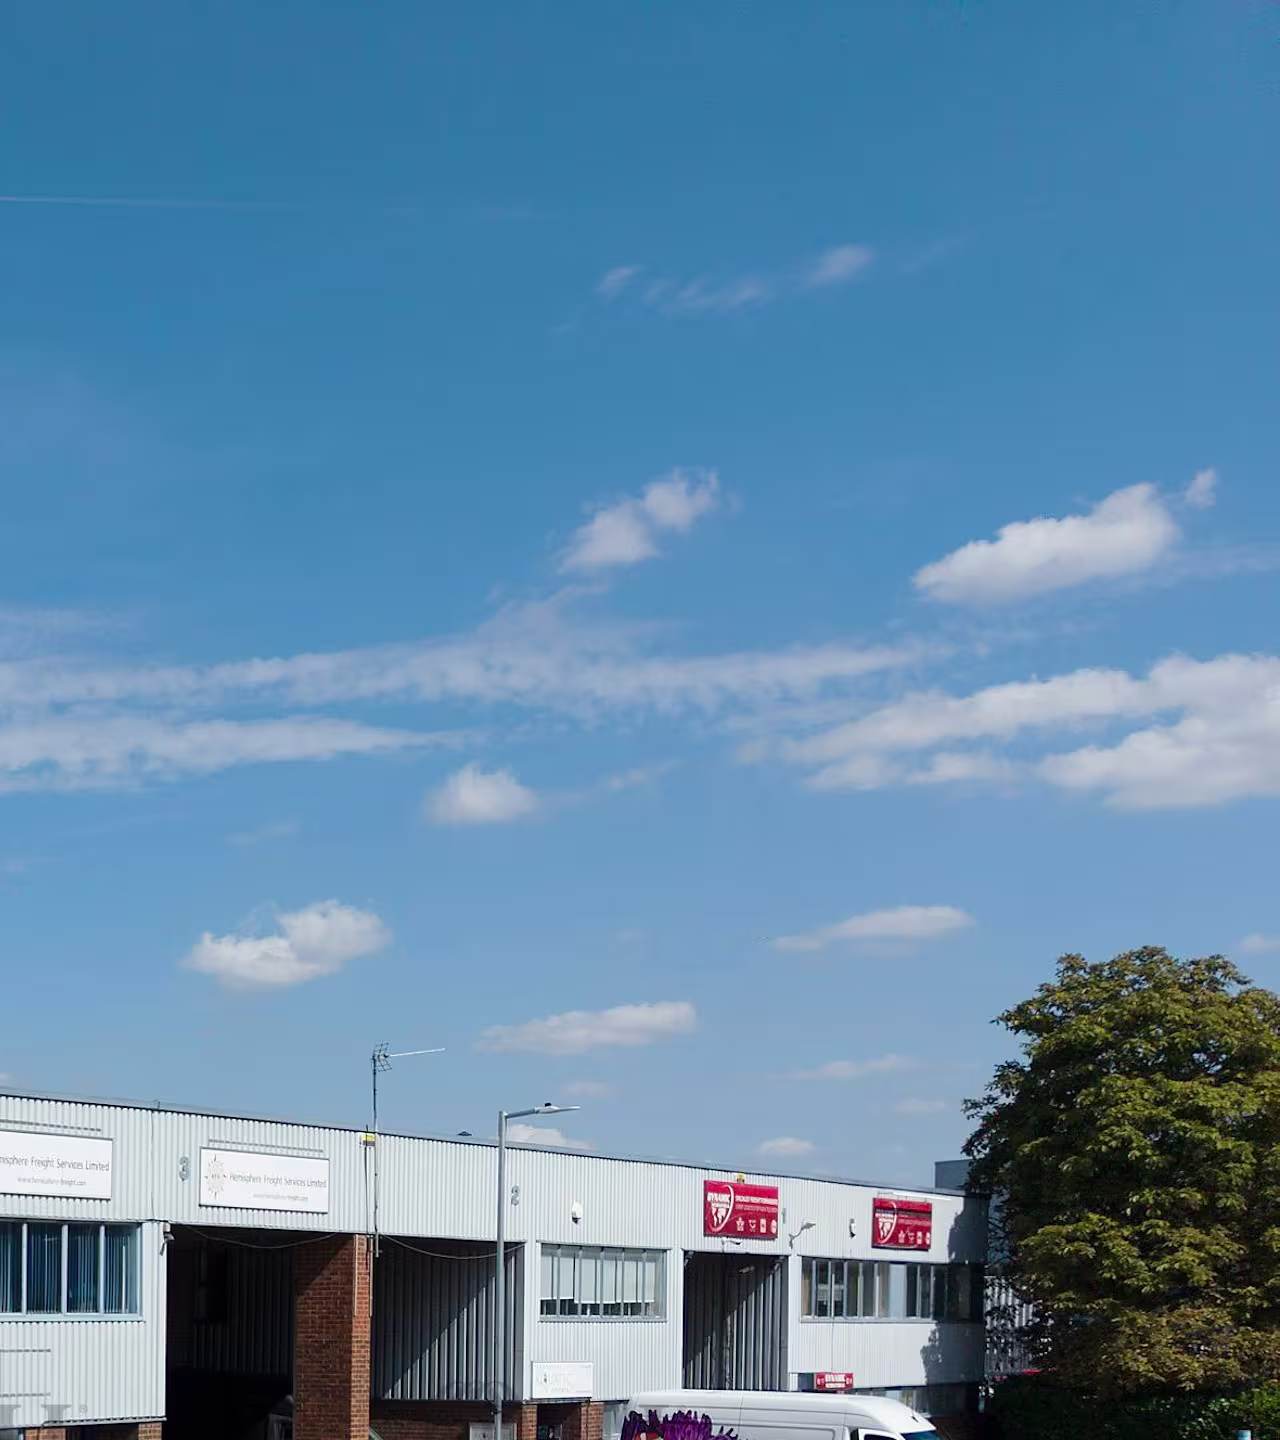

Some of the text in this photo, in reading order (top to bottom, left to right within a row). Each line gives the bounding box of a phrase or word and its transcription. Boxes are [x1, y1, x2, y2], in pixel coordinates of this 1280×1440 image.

[30, 1156, 54, 1171] Freight
[56, 1158, 84, 1170] Services
[85, 1160, 110, 1172] Limited
[178, 1155, 190, 1182] 3
